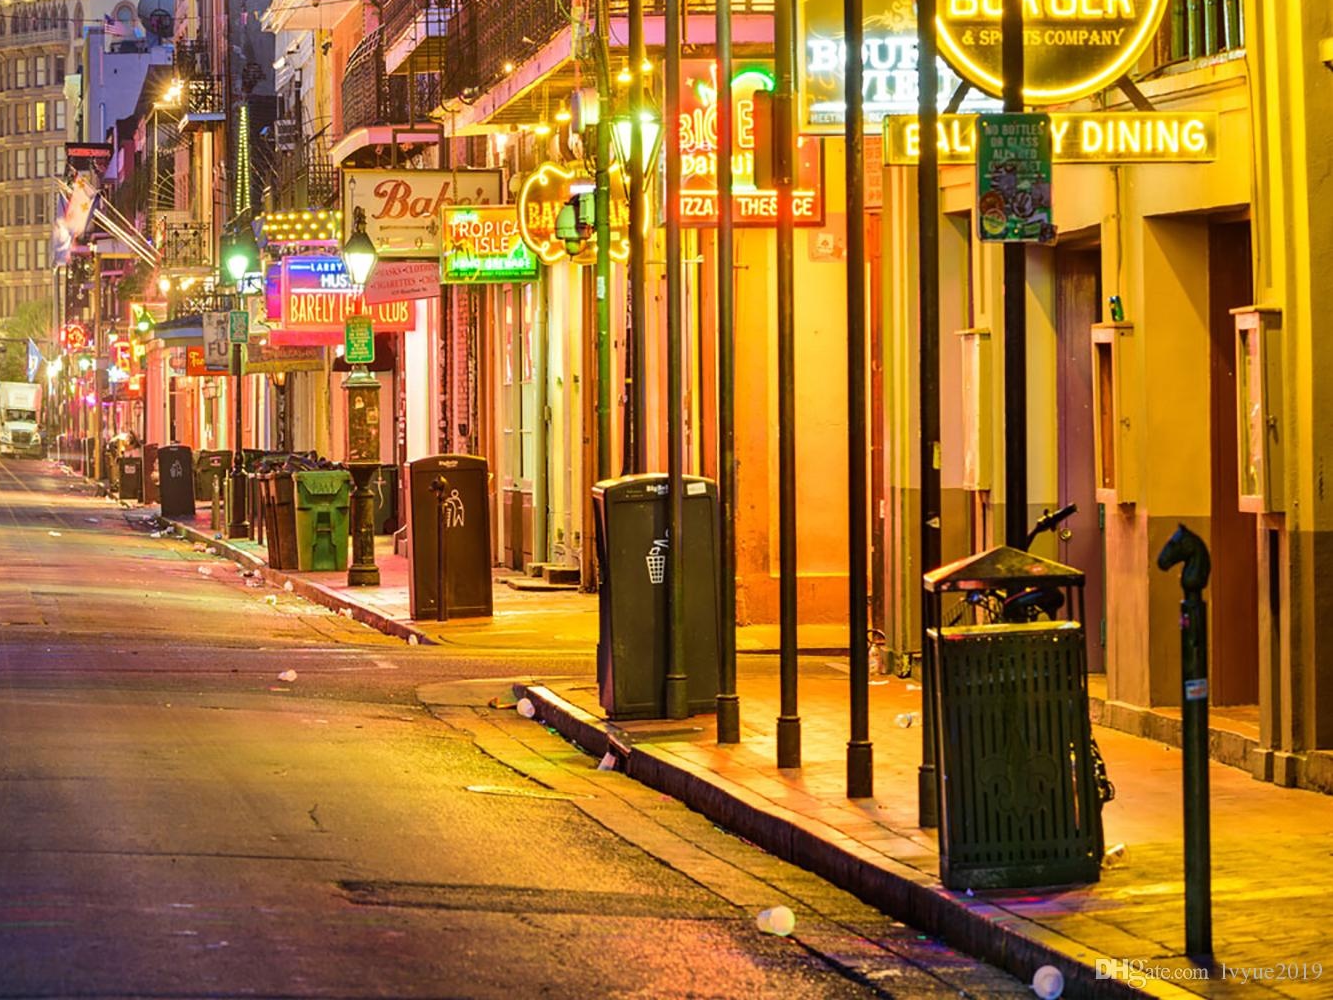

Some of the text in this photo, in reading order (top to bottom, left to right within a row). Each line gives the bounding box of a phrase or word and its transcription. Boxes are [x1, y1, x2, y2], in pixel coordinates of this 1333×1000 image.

[1044, 27, 1126, 46] COMPANY
[1081, 118, 1208, 154] DINING
[448, 220, 520, 238] TROPICA
[474, 237, 510, 253] ISLE
[290, 292, 335, 323] BARELY
[379, 302, 409, 323] CLUB
